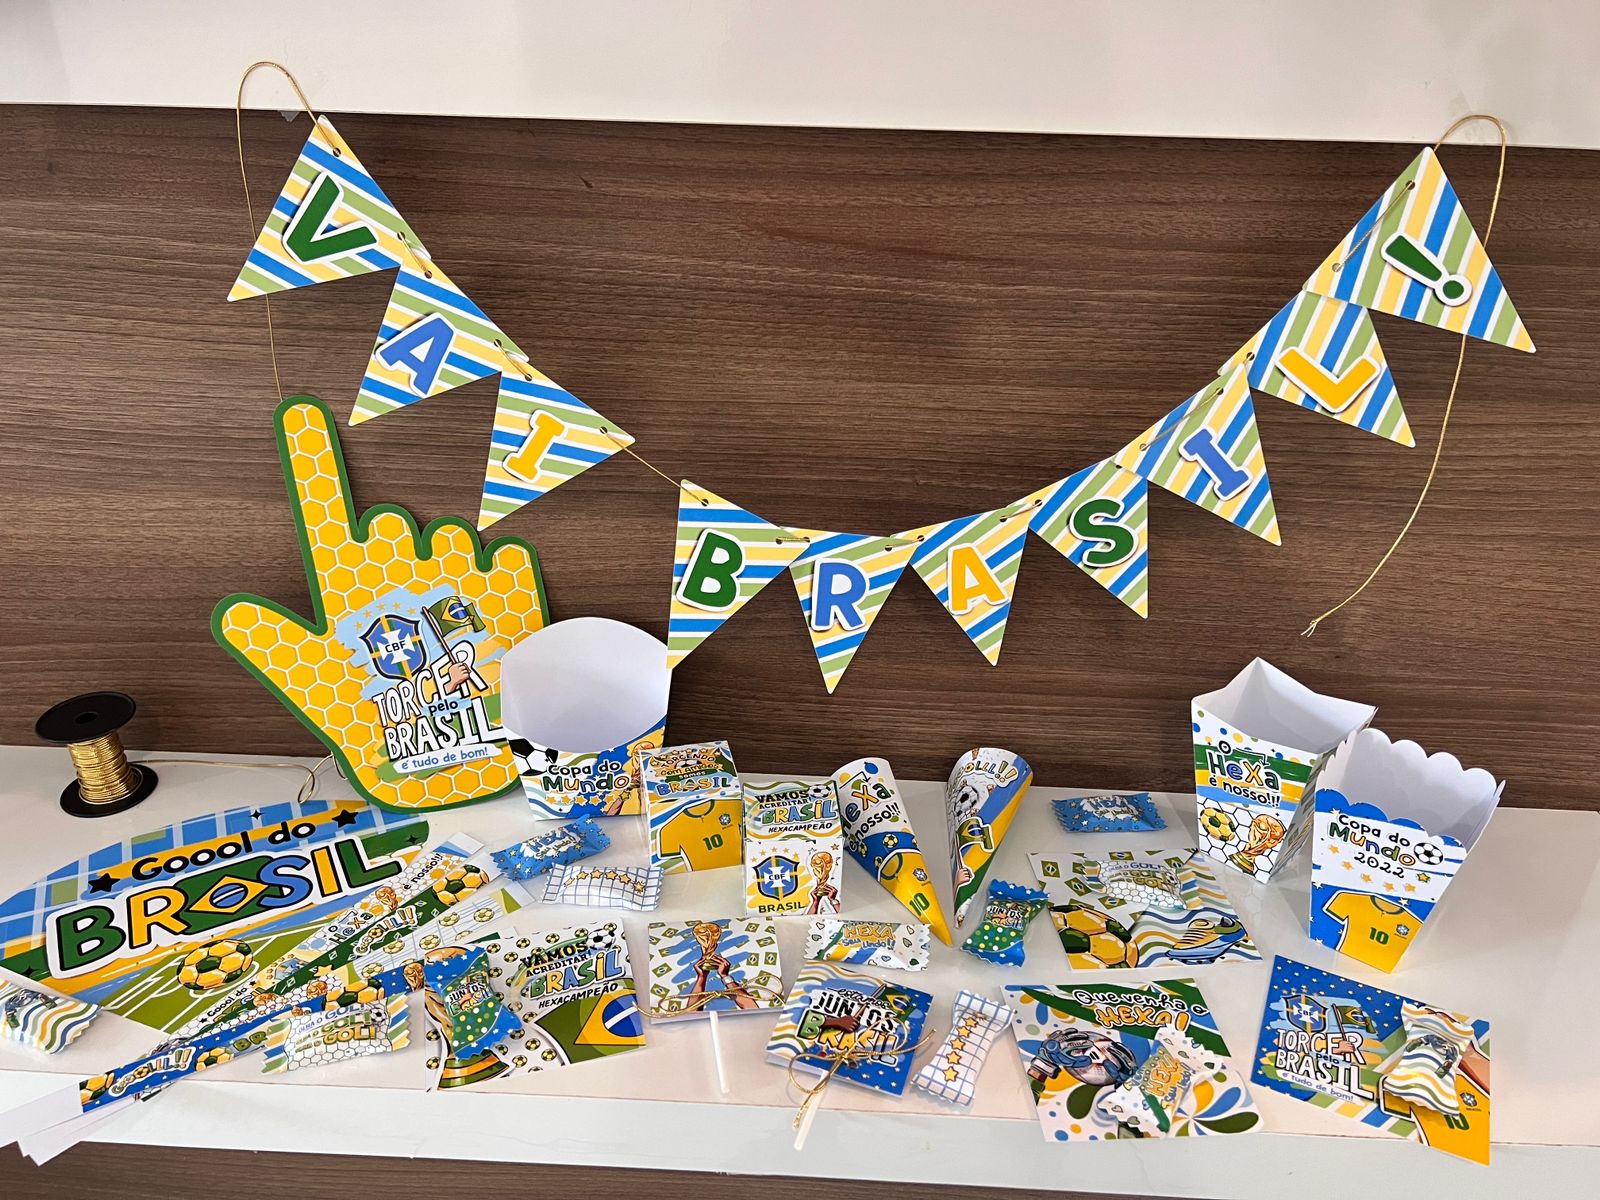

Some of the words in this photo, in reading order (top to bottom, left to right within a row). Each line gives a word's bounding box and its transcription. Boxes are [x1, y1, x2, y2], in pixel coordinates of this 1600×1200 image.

[385, 640, 406, 653] CBF
[372, 640, 489, 727] TORCER
[428, 699, 459, 717] pelo
[384, 697, 507, 762] BRASIL
[412, 756, 439, 767] tudo
[443, 750, 457, 762] de
[460, 746, 489, 759] bom!
[661, 753, 716, 768] TORCENDO
[548, 764, 592, 779] Copa
[598, 760, 621, 772] do
[542, 773, 630, 792] Mundo
[656, 777, 731, 796] BRASIL
[755, 790, 809, 804] VAMOS
[1222, 782, 1280, 807] nosso!!!
[768, 821, 833, 833] HEXACAMPEÃO
[855, 802, 900, 841] nosso!!!
[1339, 814, 1381, 838] Copa
[1388, 832, 1411, 847] do
[132, 830, 253, 882] Goool
[268, 821, 317, 845] do
[703, 833, 724, 851] 10
[1329, 822, 1416, 866] Mundo
[1354, 852, 1405, 878] 2022
[56, 837, 402, 973] BRASIL
[758, 902, 808, 914] BRASIL
[909, 892, 930, 916] 10
[1369, 926, 1389, 945] 10
[519, 938, 589, 968] VAMOS
[236, 987, 248, 997] do
[538, 981, 619, 1009] HEXACAMPEÃO
[1074, 990, 1119, 1005] Que
[1123, 993, 1187, 1011] venha
[323, 1024, 376, 1046] GOL!
[1277, 1029, 1367, 1065] TORCER
[1316, 1053, 1340, 1065] pelo
[1275, 1048, 1375, 1101] BRASIL
